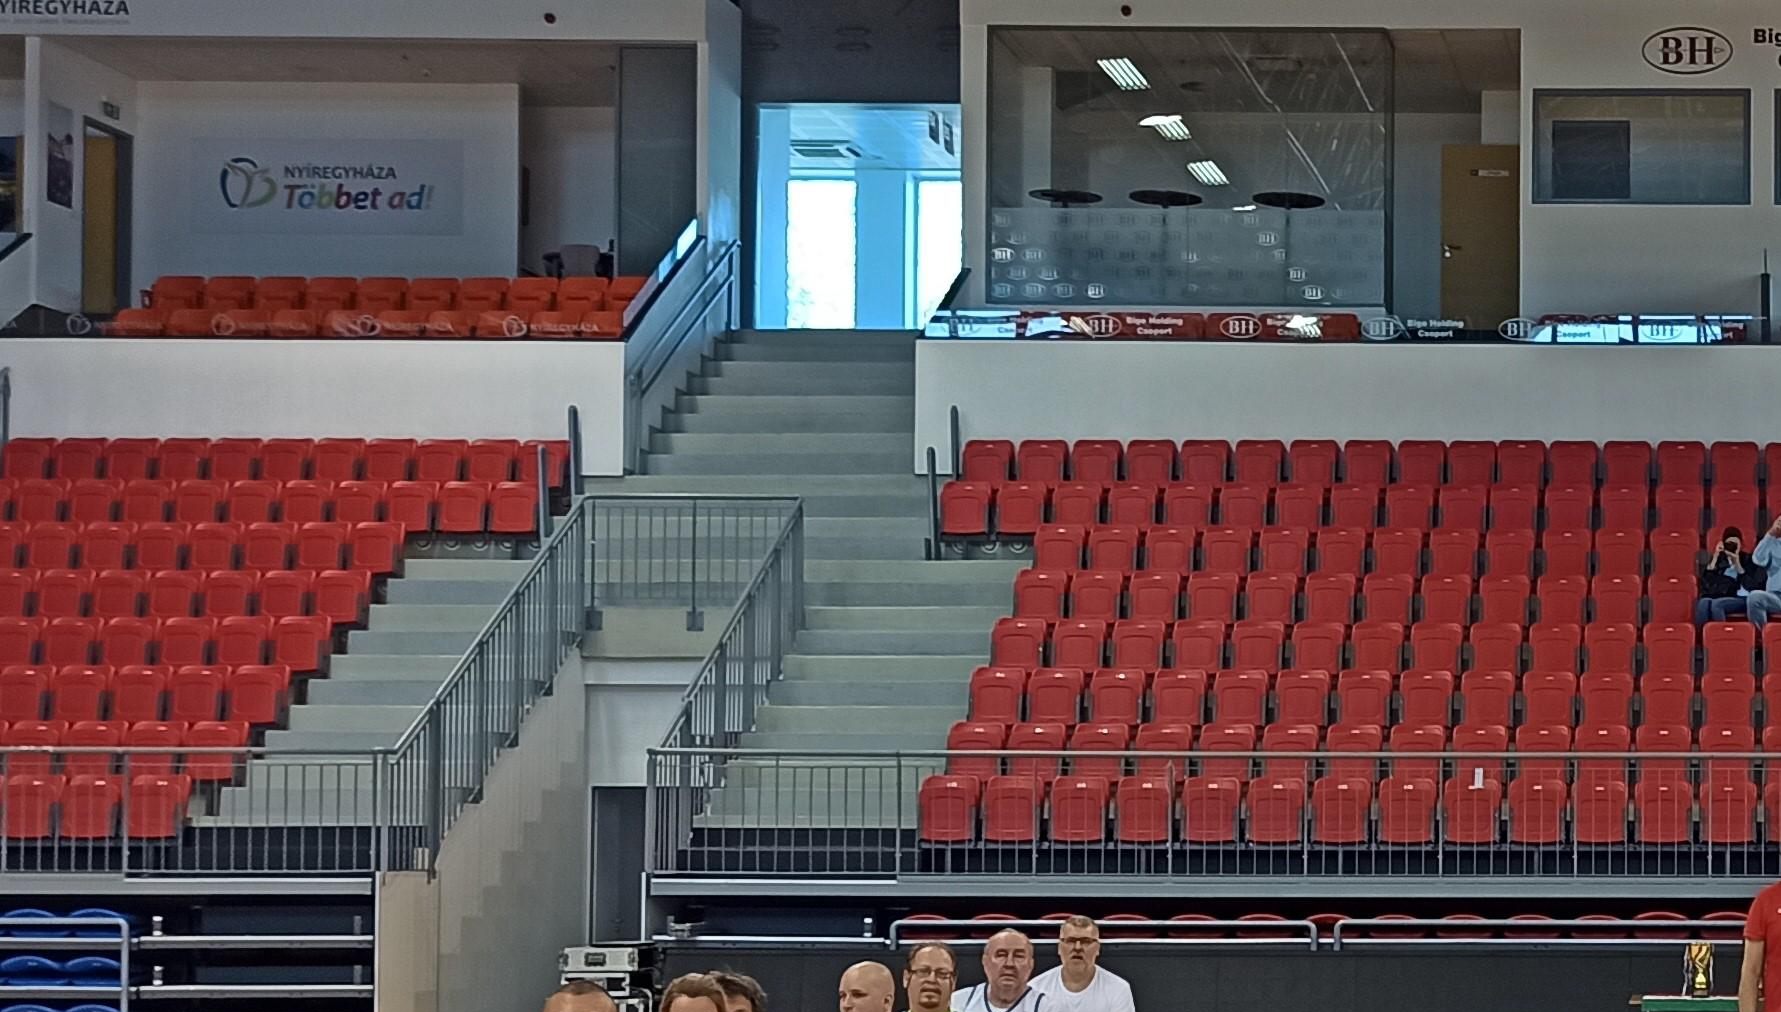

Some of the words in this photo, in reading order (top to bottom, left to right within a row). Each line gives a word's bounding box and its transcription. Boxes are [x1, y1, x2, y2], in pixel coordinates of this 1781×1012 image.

[1659, 36, 1716, 65] BH
[284, 164, 397, 180] NYÍREGYHÁZA
[283, 183, 382, 210] Többet
[388, 183, 435, 210] ad!
